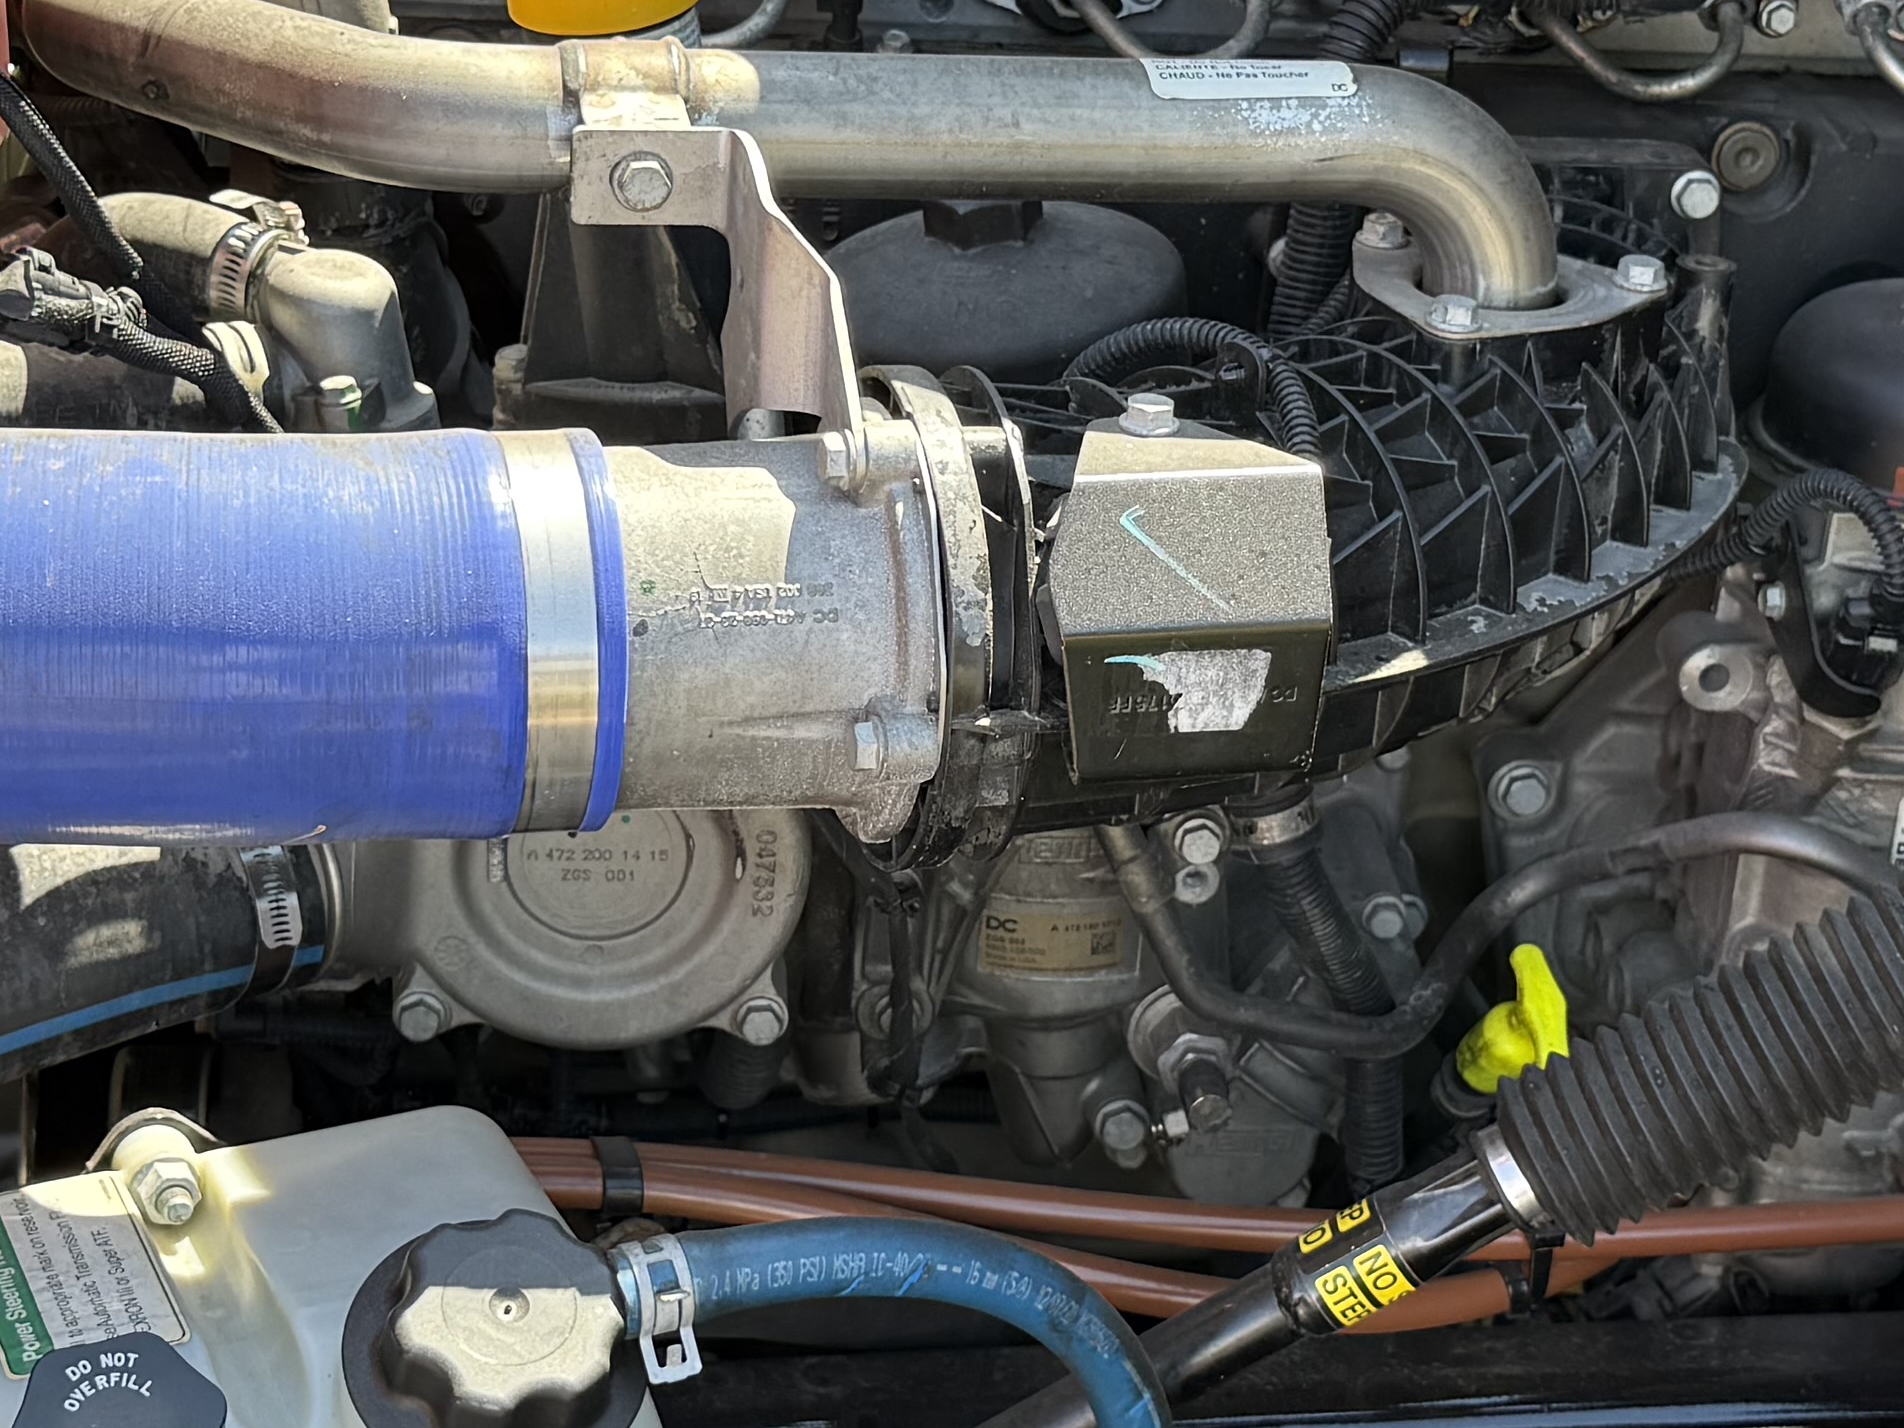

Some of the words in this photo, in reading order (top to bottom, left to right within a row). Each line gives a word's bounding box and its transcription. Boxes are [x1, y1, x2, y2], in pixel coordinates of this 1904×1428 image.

[1159, 71, 1205, 80] CHAUD
[1261, 71, 1309, 80] Toucher
[1331, 83, 1348, 92] DC
[546, 848, 575, 862] 472
[582, 848, 613, 862] 200
[623, 850, 641, 861] 14
[650, 849, 669, 862] 15
[561, 869, 592, 881] ZGS
[986, 915, 1018, 933] DC
[31, 1236, 45, 1249] on
[59, 1221, 91, 1279] Transmission
[36, 1250, 55, 1273] mark
[102, 1248, 125, 1275] Super
[1358, 1250, 1397, 1291] NO
[116, 1276, 128, 1285] or
[46, 1274, 83, 1327] appropriate
[81, 1280, 113, 1327] Automatic
[124, 1297, 153, 1332] EXRON
[14, 1321, 43, 1362] Power
[67, 1329, 83, 1338] to
[65, 1360, 92, 1382] DO
[99, 1352, 139, 1368] NOT
[64, 1372, 153, 1412] OVERFILL
